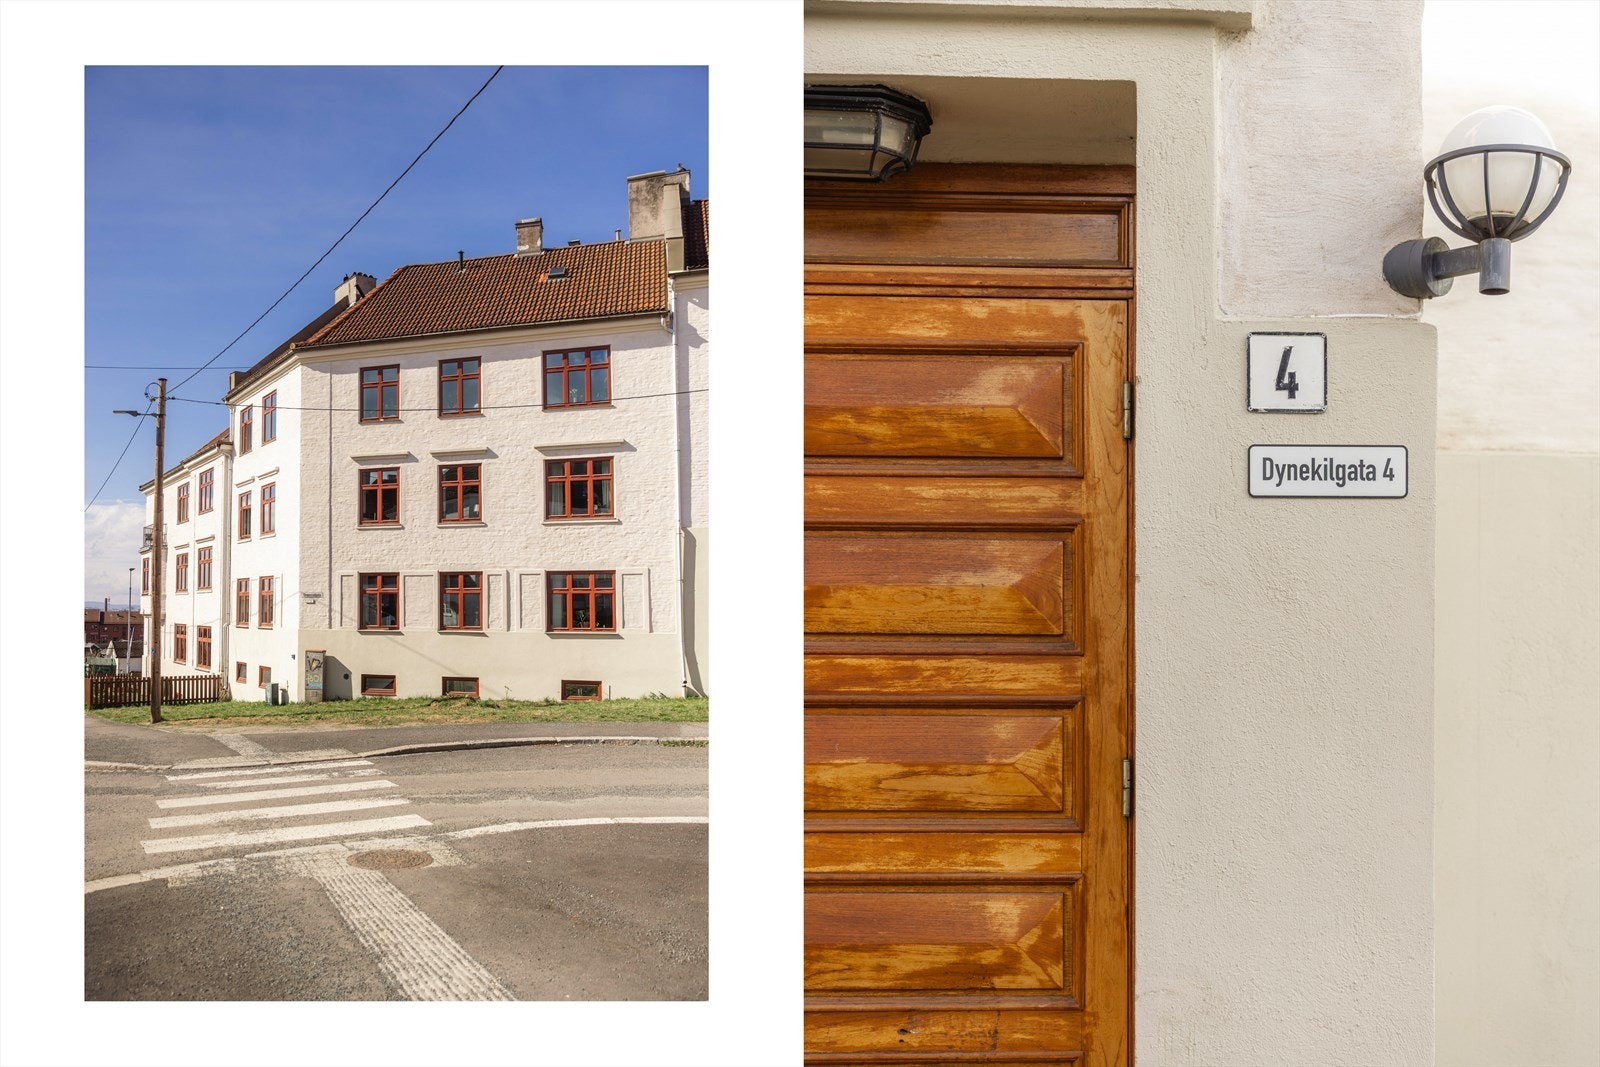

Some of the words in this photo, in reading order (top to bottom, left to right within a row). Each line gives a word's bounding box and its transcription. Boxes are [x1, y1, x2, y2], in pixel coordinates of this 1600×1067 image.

[1275, 345, 1299, 399] 4
[1262, 457, 1377, 488] Dynekilgata
[1382, 457, 1395, 482] 4
